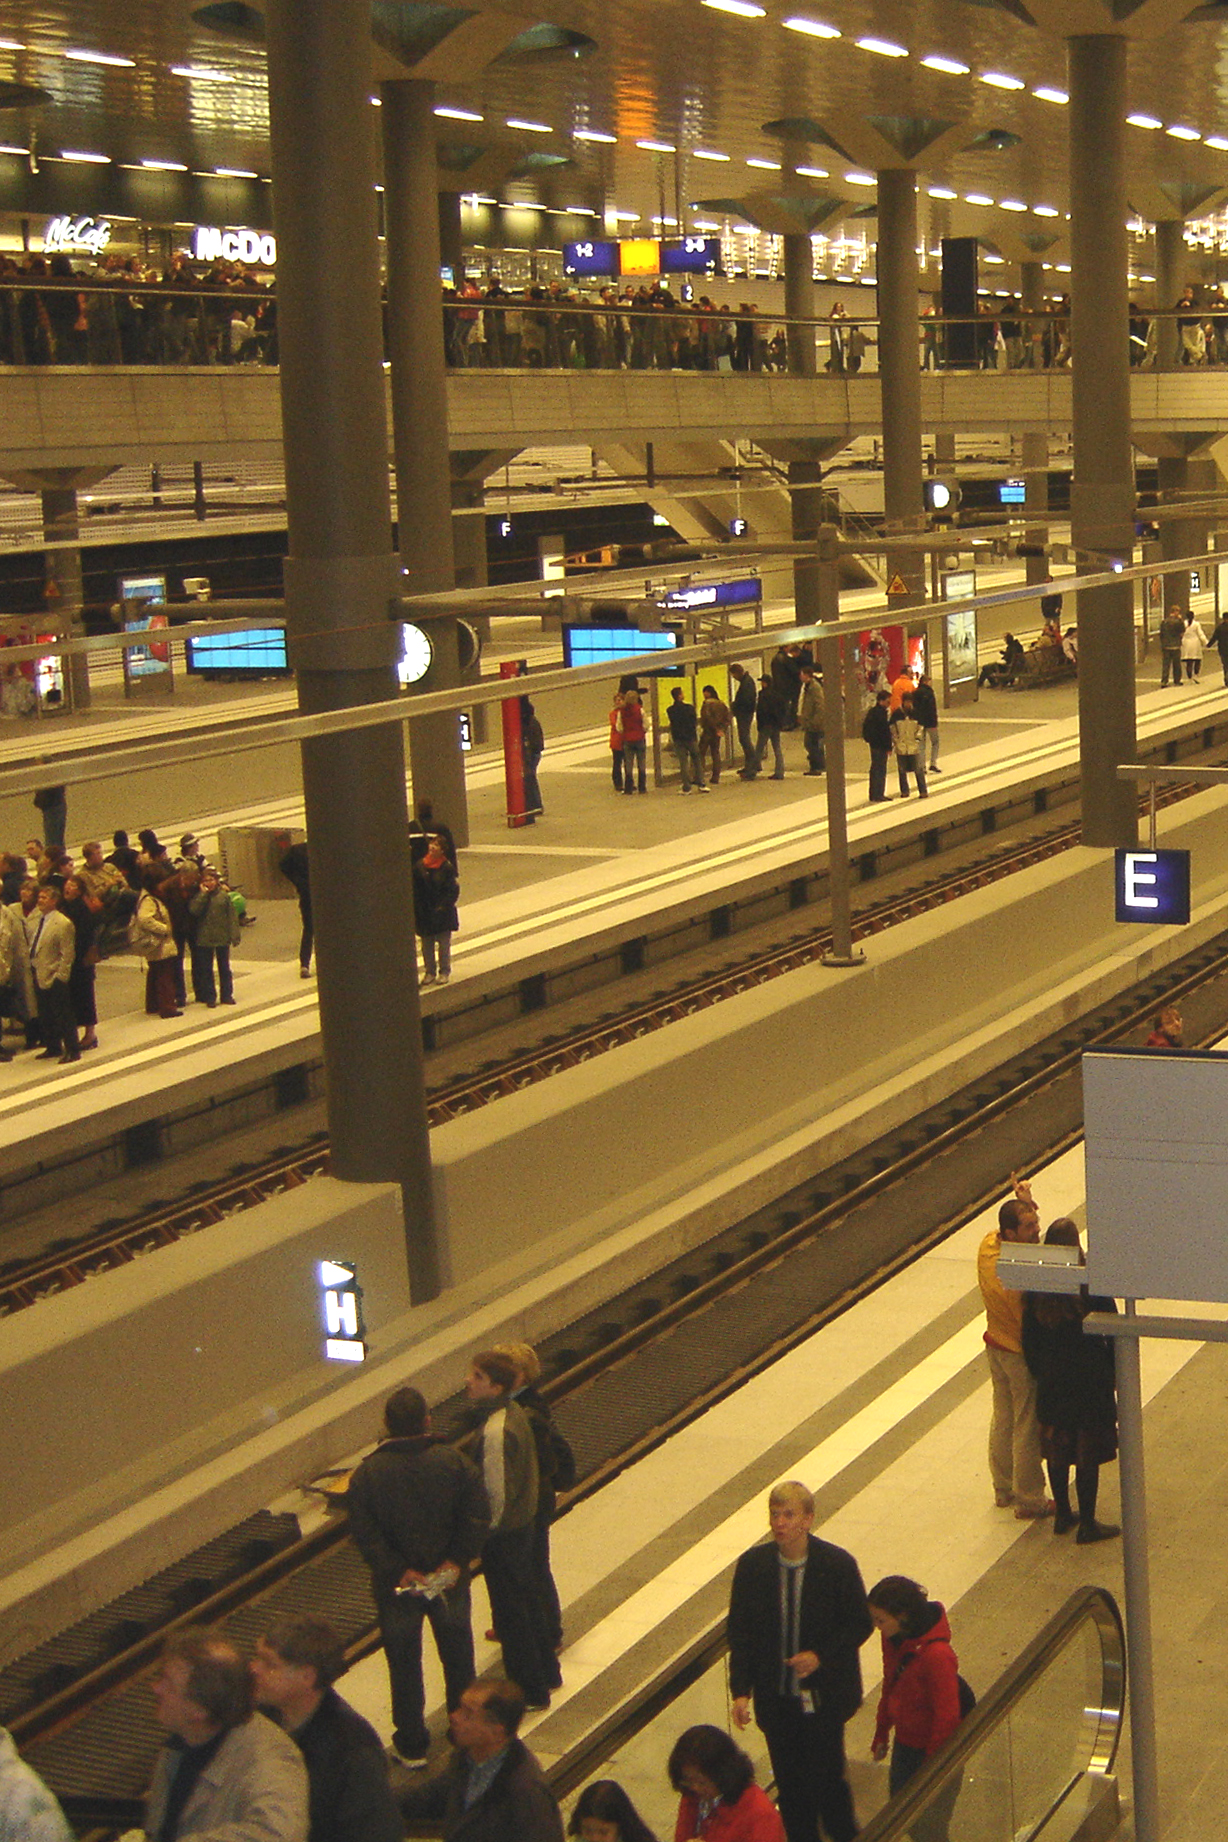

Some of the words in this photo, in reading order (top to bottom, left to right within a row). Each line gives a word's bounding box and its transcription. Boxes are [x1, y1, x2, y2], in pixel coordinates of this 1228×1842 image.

[576, 243, 594, 258] 1-2
[684, 285, 693, 301] 2
[502, 522, 511, 537] F
[735, 520, 745, 536] F
[1191, 578, 1199, 588] H
[1125, 853, 1159, 908] E
[325, 1290, 358, 1335] H
